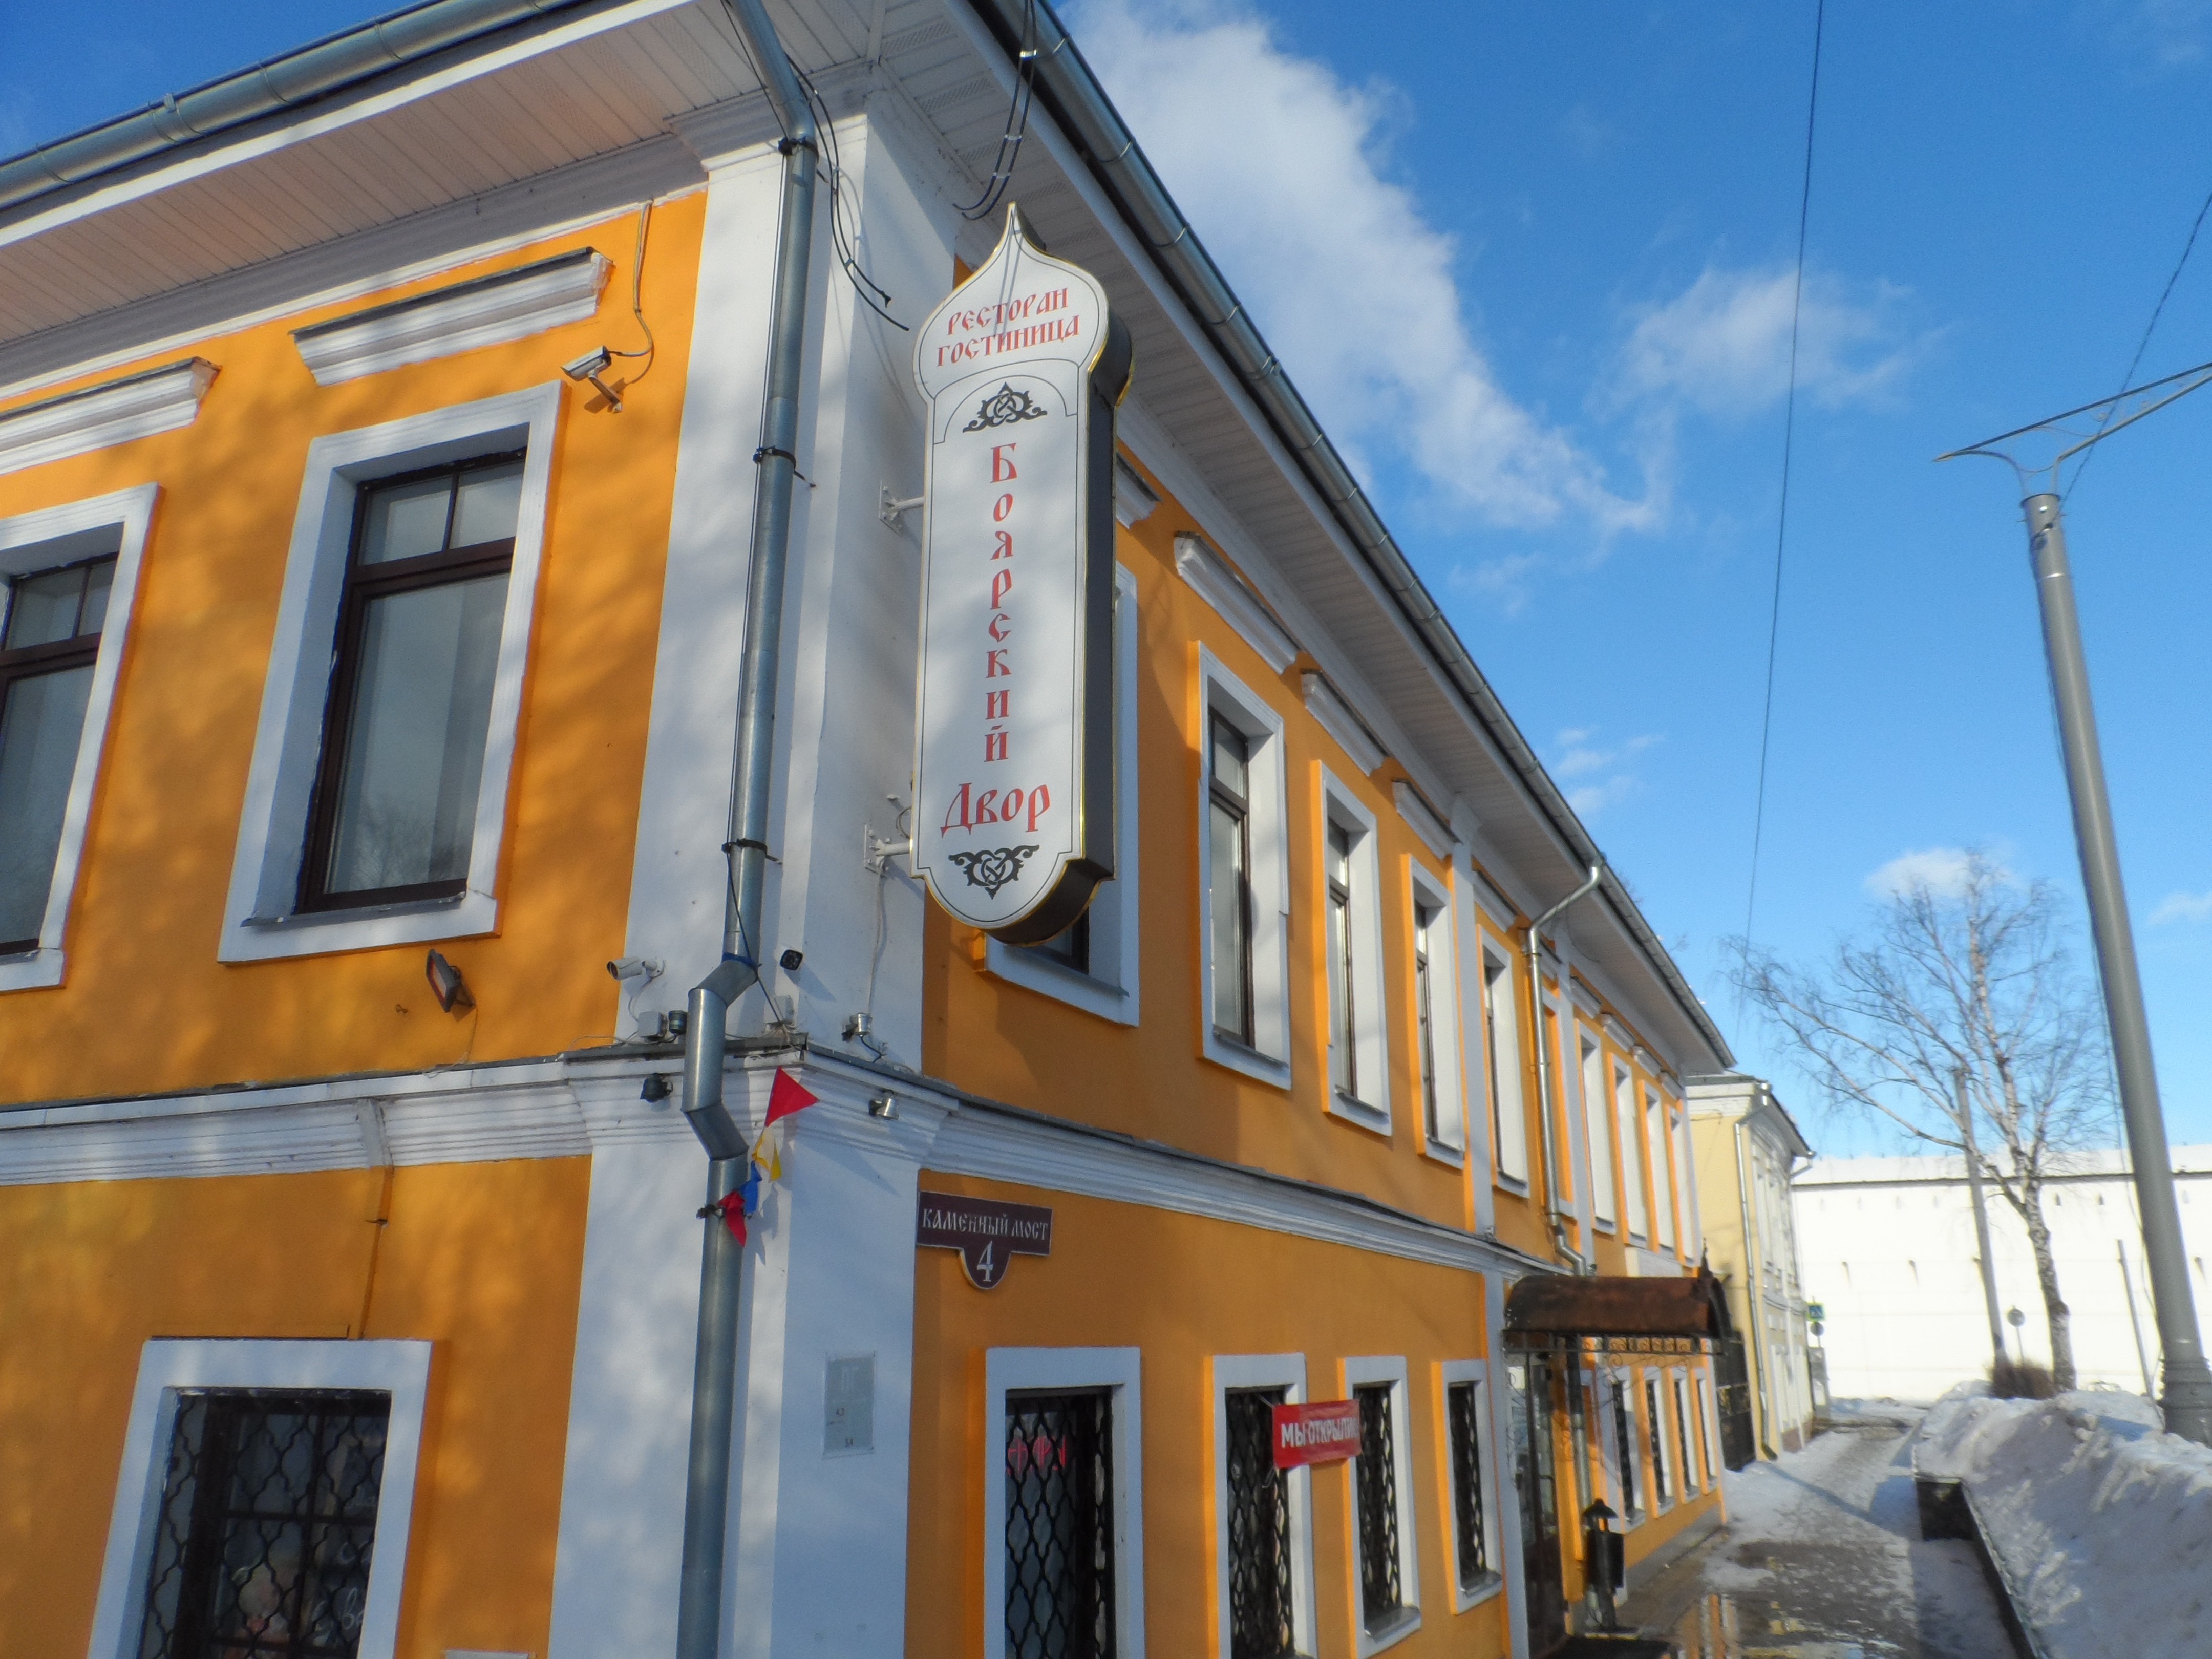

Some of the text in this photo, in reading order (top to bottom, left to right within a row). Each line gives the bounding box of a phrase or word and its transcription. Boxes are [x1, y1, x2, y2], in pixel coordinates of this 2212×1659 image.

[947, 288, 1069, 335] РЕСТОРАН
[937, 315, 1080, 367] ГОСТИНИЦА
[940, 782, 1050, 839] Двор
[922, 1208, 1048, 1240] КАМЕННЫЙ МОСТ
[976, 1241, 994, 1282] 4
